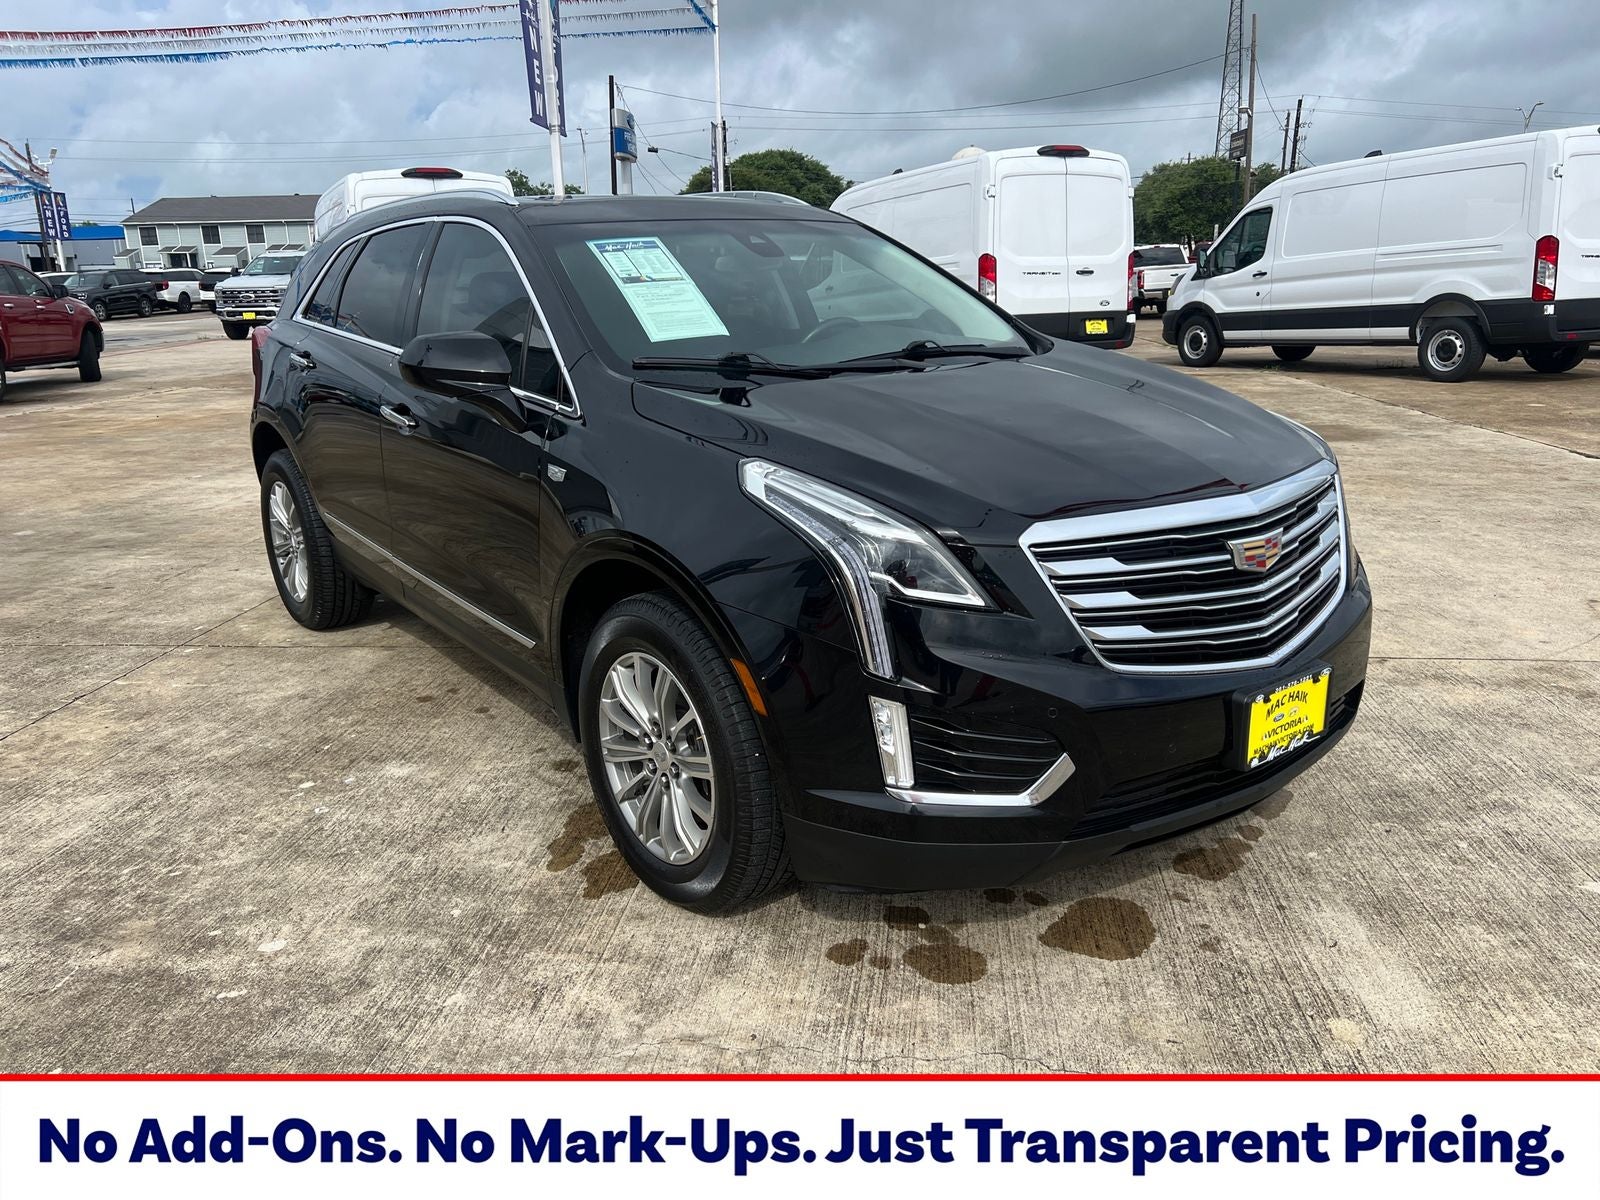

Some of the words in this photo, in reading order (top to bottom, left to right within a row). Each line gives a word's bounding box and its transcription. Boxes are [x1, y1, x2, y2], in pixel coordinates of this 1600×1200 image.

[528, 25, 543, 117] NEW
[45, 209, 56, 237] NEW
[60, 210, 69, 238] FORD
[1265, 694, 1287, 720] MAC
[1287, 690, 1309, 704] HAIK
[1266, 716, 1302, 738] VICTORIA
